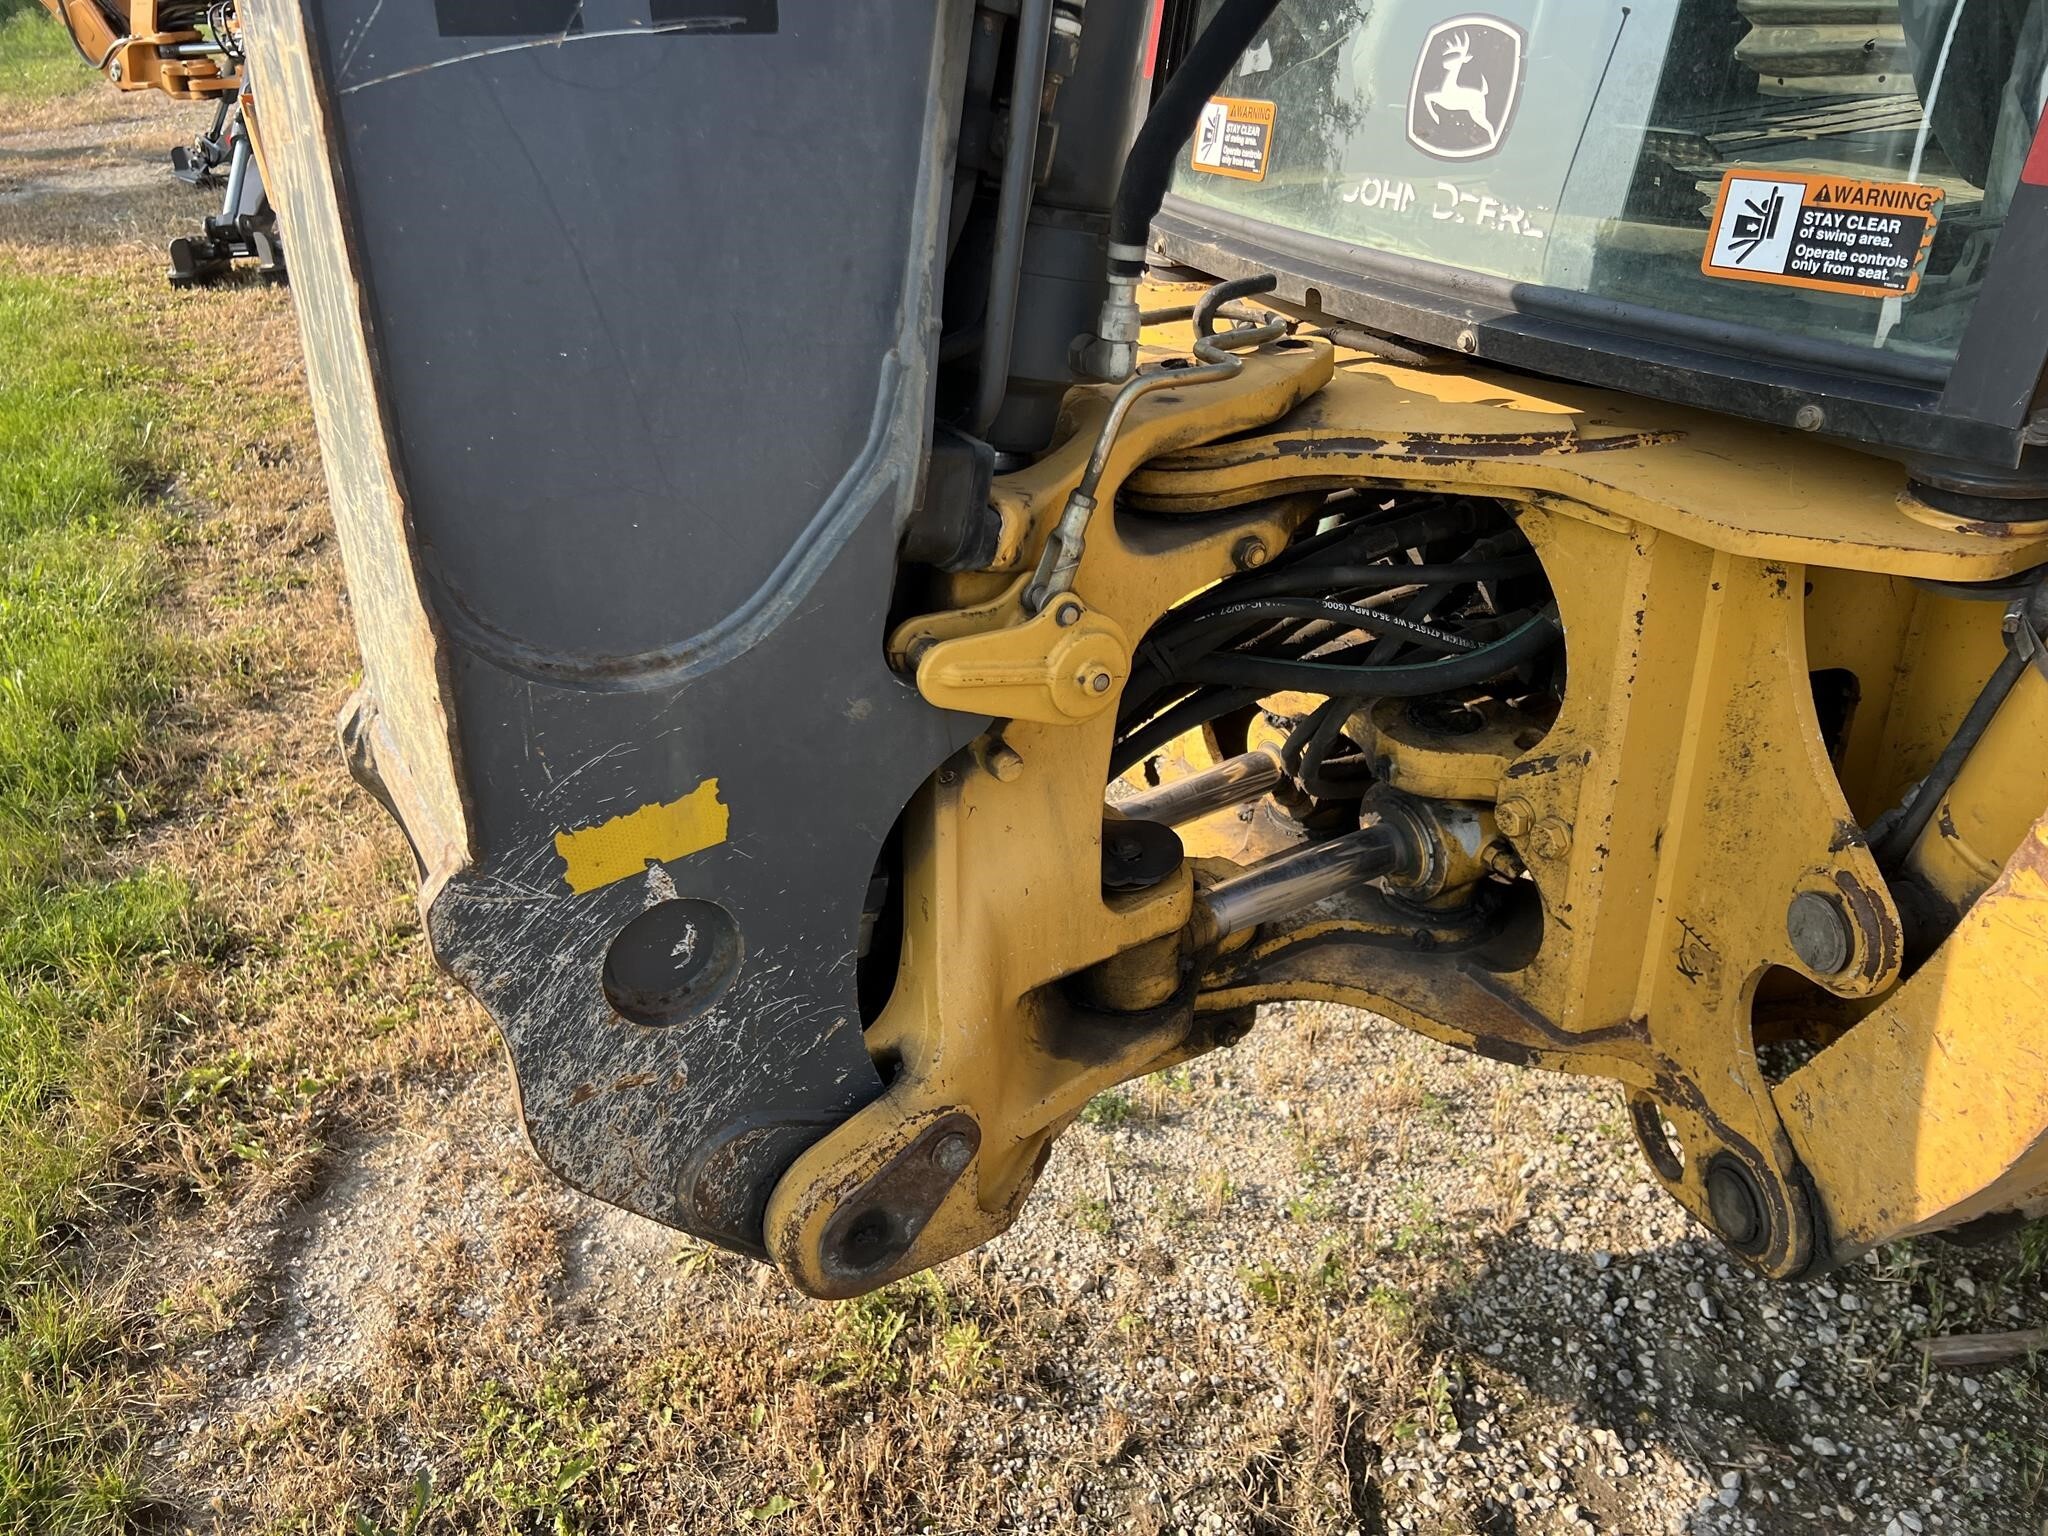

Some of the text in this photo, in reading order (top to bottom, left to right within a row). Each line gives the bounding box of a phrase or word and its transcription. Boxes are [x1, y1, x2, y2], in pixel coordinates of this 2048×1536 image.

[1237, 105, 1271, 120] WARNING
[1226, 123, 1261, 137] STAY CLEAR
[1834, 186, 1932, 211] WARNING
[1803, 211, 1901, 234] STAY CLEAR
[1799, 227, 1894, 248] of swing area.
[1795, 244, 1909, 269] Operate controls
[1791, 258, 1890, 281] only from seat.
[1348, 604, 1370, 616] MPa
